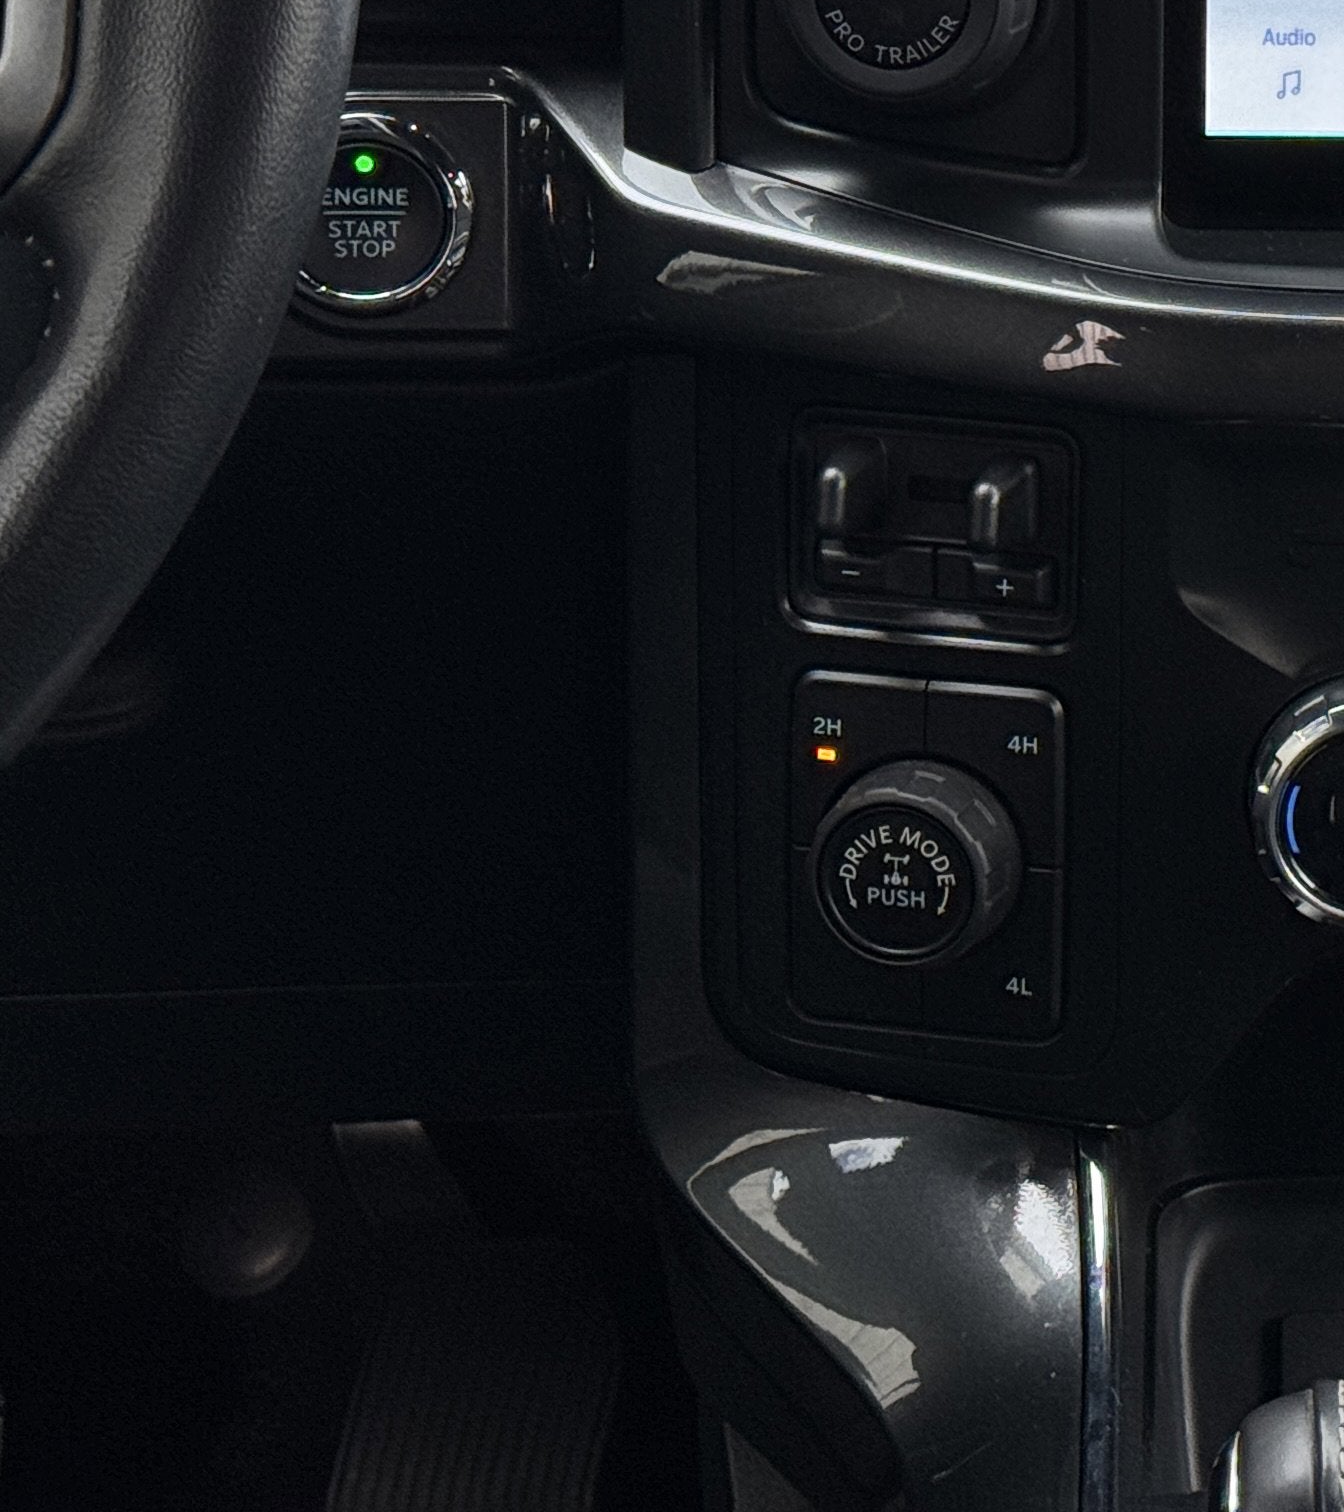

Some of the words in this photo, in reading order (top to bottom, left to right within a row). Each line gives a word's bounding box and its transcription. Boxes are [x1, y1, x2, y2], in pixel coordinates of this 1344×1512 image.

[825, 9, 865, 52] PRO
[874, 15, 960, 65] TRAILER
[1262, 28, 1317, 48] Audio
[322, 188, 409, 207] ENGINE
[328, 220, 401, 239] START
[334, 240, 396, 259] STOP
[813, 717, 842, 737] 2H
[1008, 735, 1038, 755] 4H
[839, 825, 893, 880] DRIVE
[900, 826, 956, 888] MODE
[867, 887, 926, 909] PUSH
[1006, 978, 1032, 996] 4L
